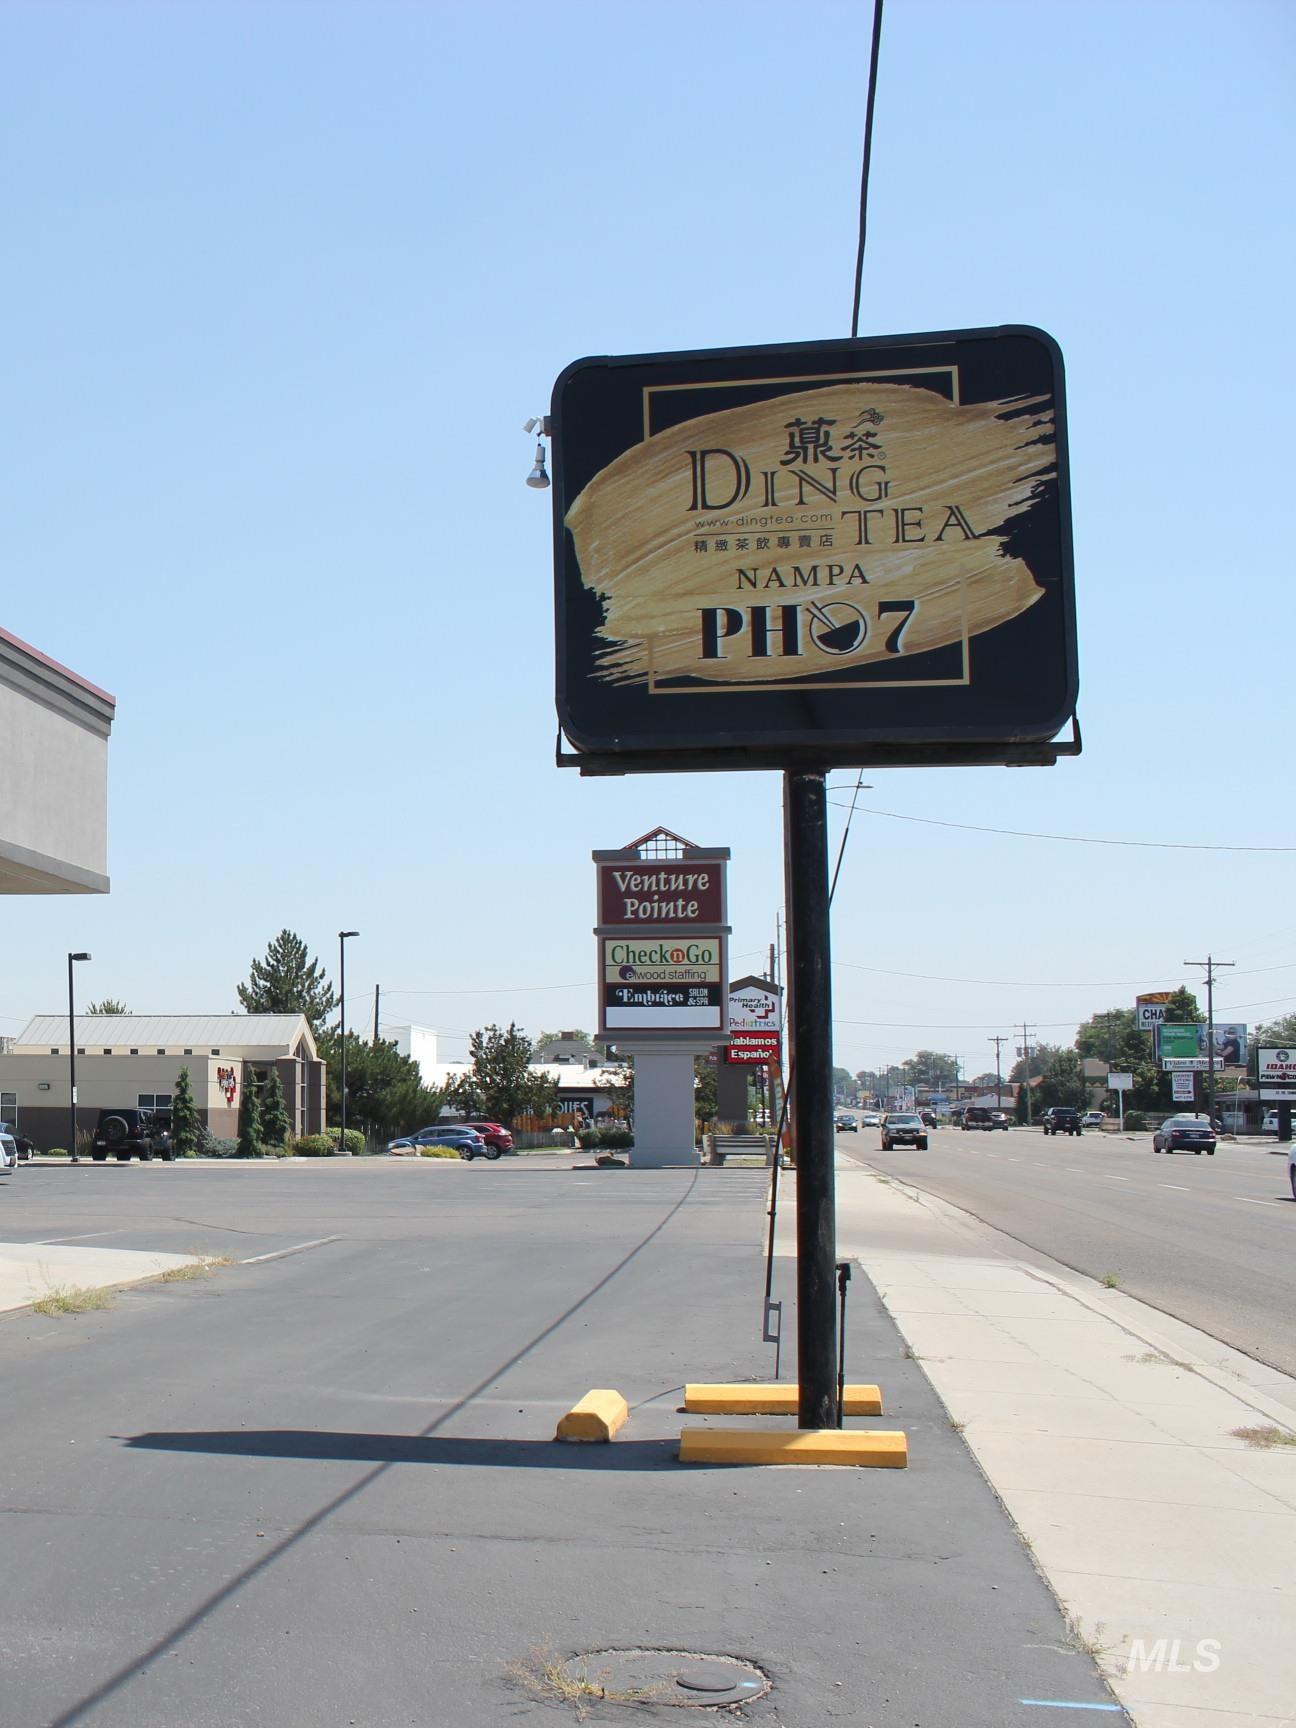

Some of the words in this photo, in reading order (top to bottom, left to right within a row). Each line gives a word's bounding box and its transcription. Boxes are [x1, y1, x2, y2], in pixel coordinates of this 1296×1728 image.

[685, 448, 891, 511] DING
[841, 505, 980, 546] TEA
[735, 563, 870, 590] NAMPA
[612, 871, 710, 893] Venture
[623, 895, 699, 919] Pointe
[625, 969, 666, 980] elwood
[668, 968, 707, 982] staffing
[615, 988, 684, 1006] Embrace
[689, 988, 708, 996] SALON
[729, 1017, 776, 1027] Pediatrics
[1142, 1008, 1165, 1020] CHA
